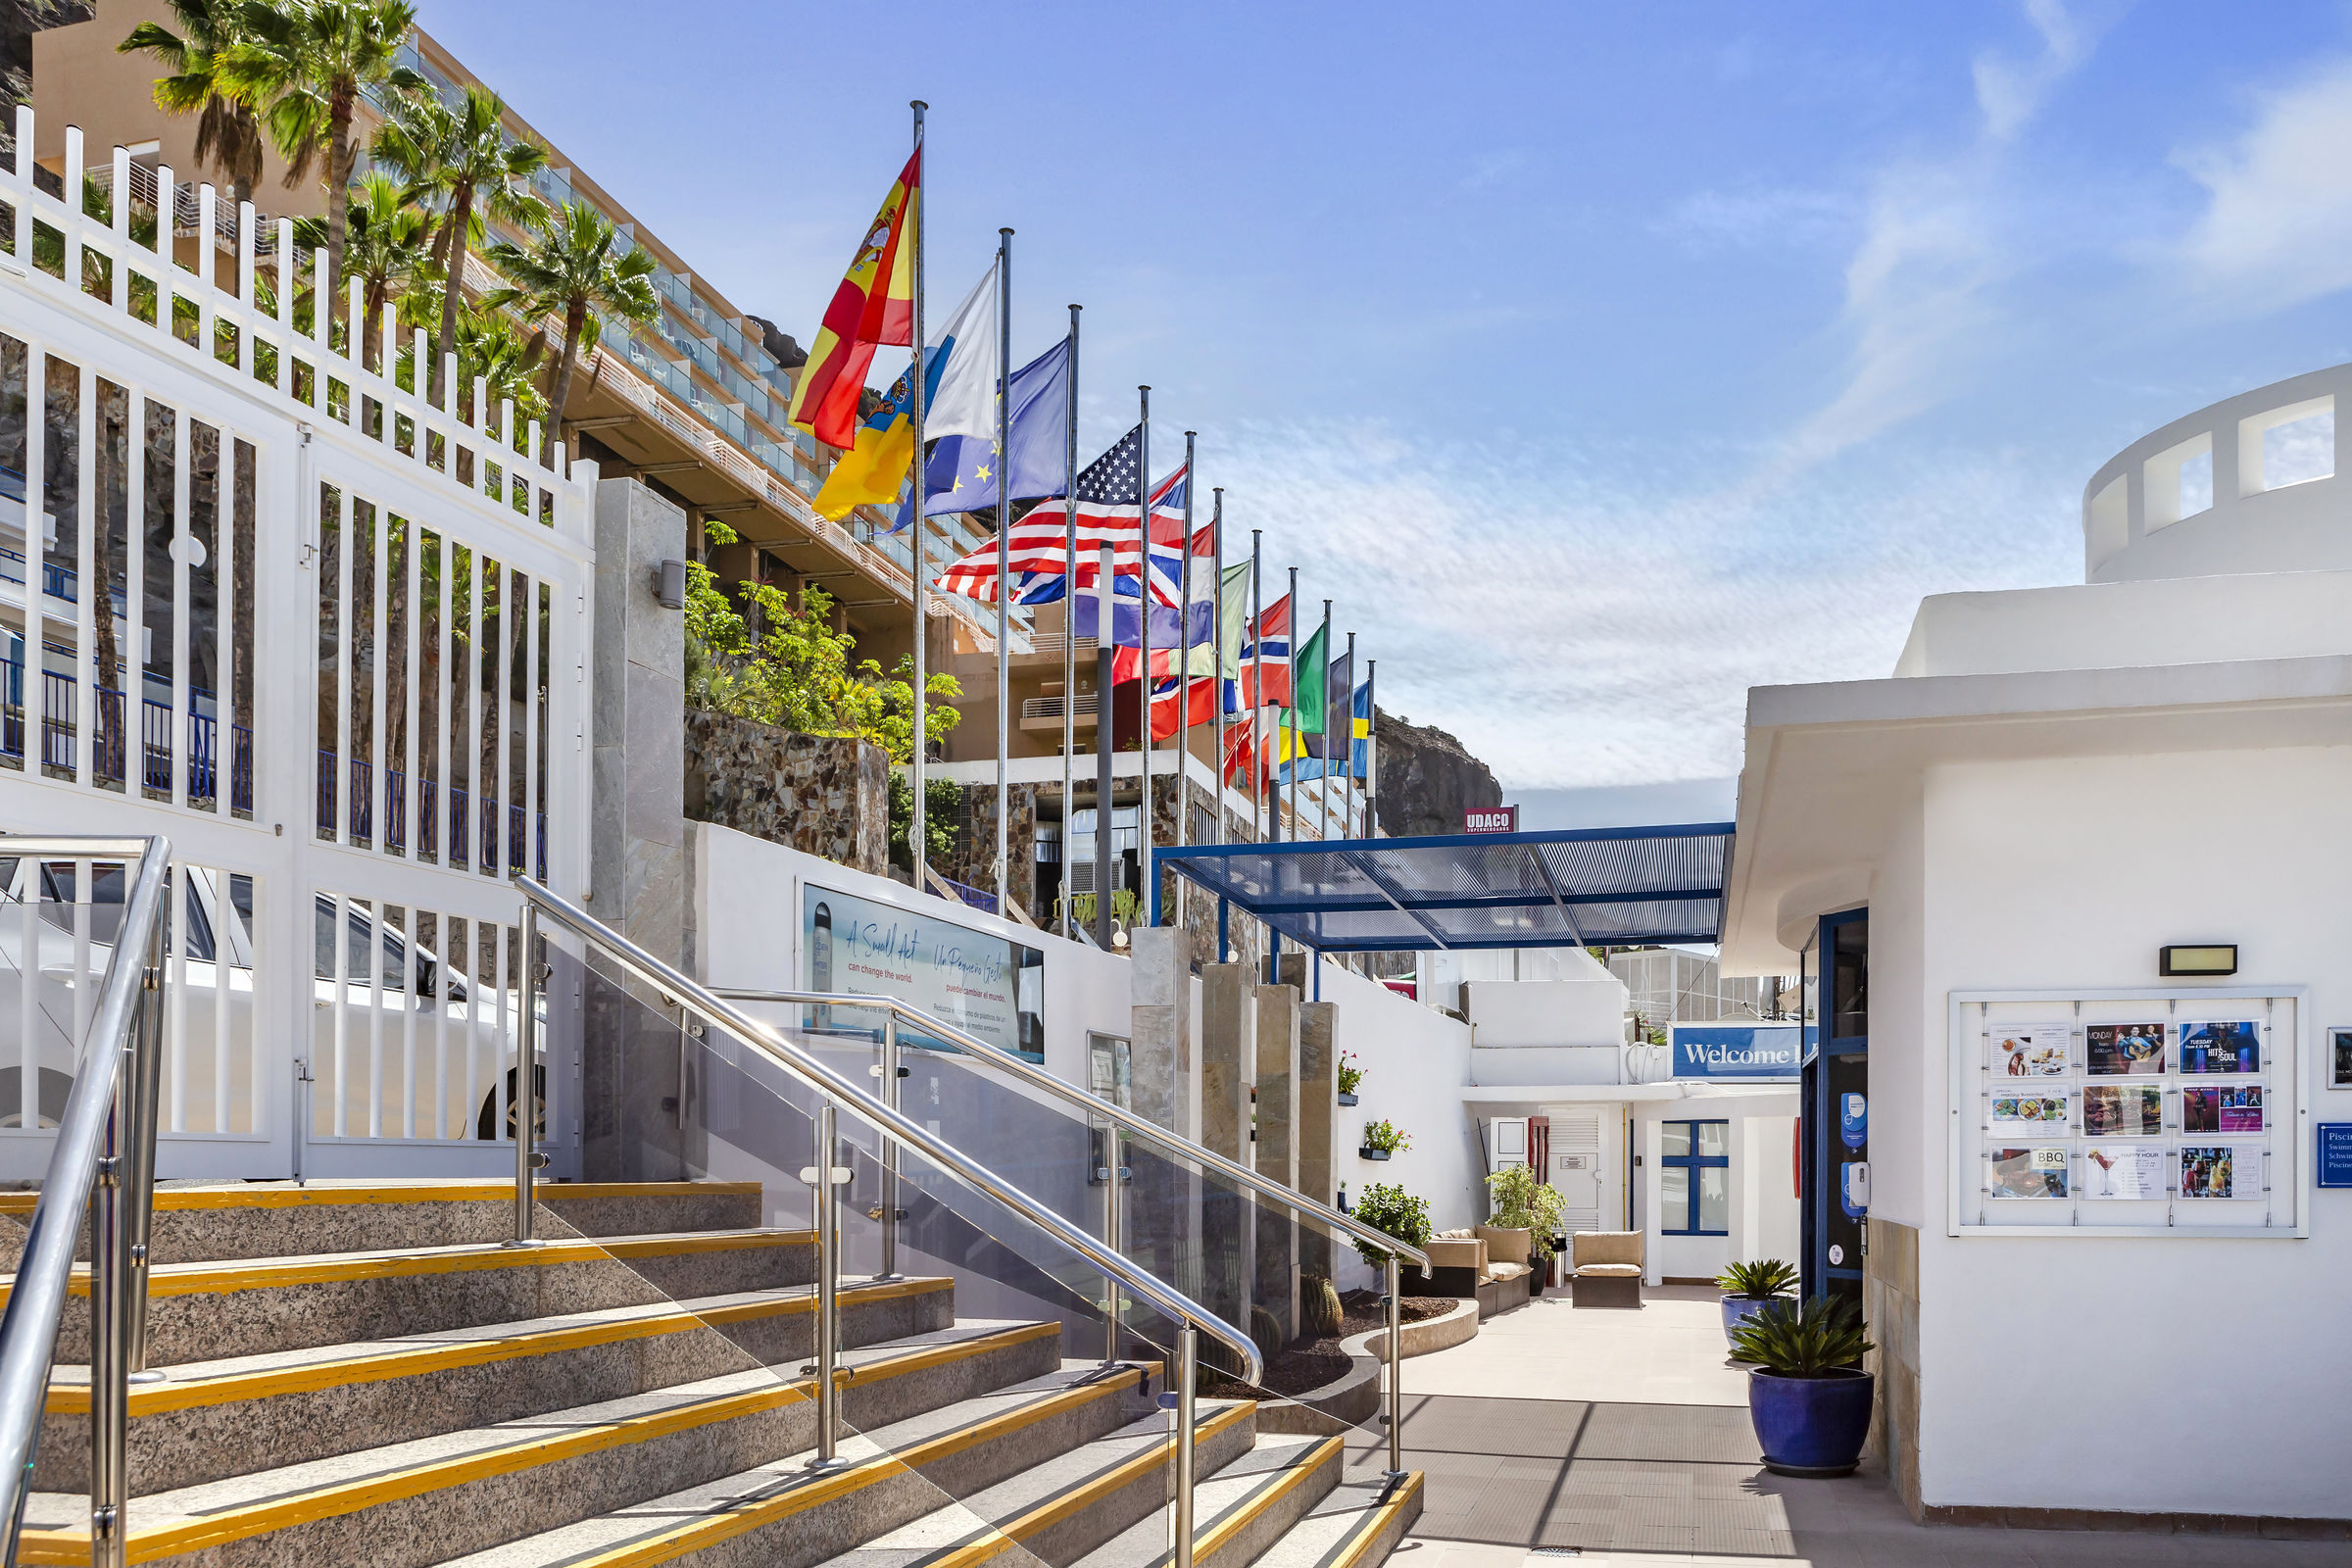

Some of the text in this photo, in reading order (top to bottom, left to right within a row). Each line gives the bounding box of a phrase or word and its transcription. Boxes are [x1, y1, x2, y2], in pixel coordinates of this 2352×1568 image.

[1467, 813, 1509, 828] UDACO
[847, 920, 858, 957] A
[862, 923, 897, 965] Small
[898, 929, 920, 968] Act
[848, 962, 860, 972] can
[860, 964, 884, 979] change
[884, 969, 895, 979] the
[946, 984, 963, 995] puede
[963, 988, 983, 998] cambiar
[2088, 1031, 2113, 1040] MONDAY
[1684, 1044, 1789, 1064] Welcome
[2208, 1049, 2224, 1057] HITS
[2328, 1132, 2352, 1141] Pisci
[2038, 1152, 2065, 1163] BBQ
